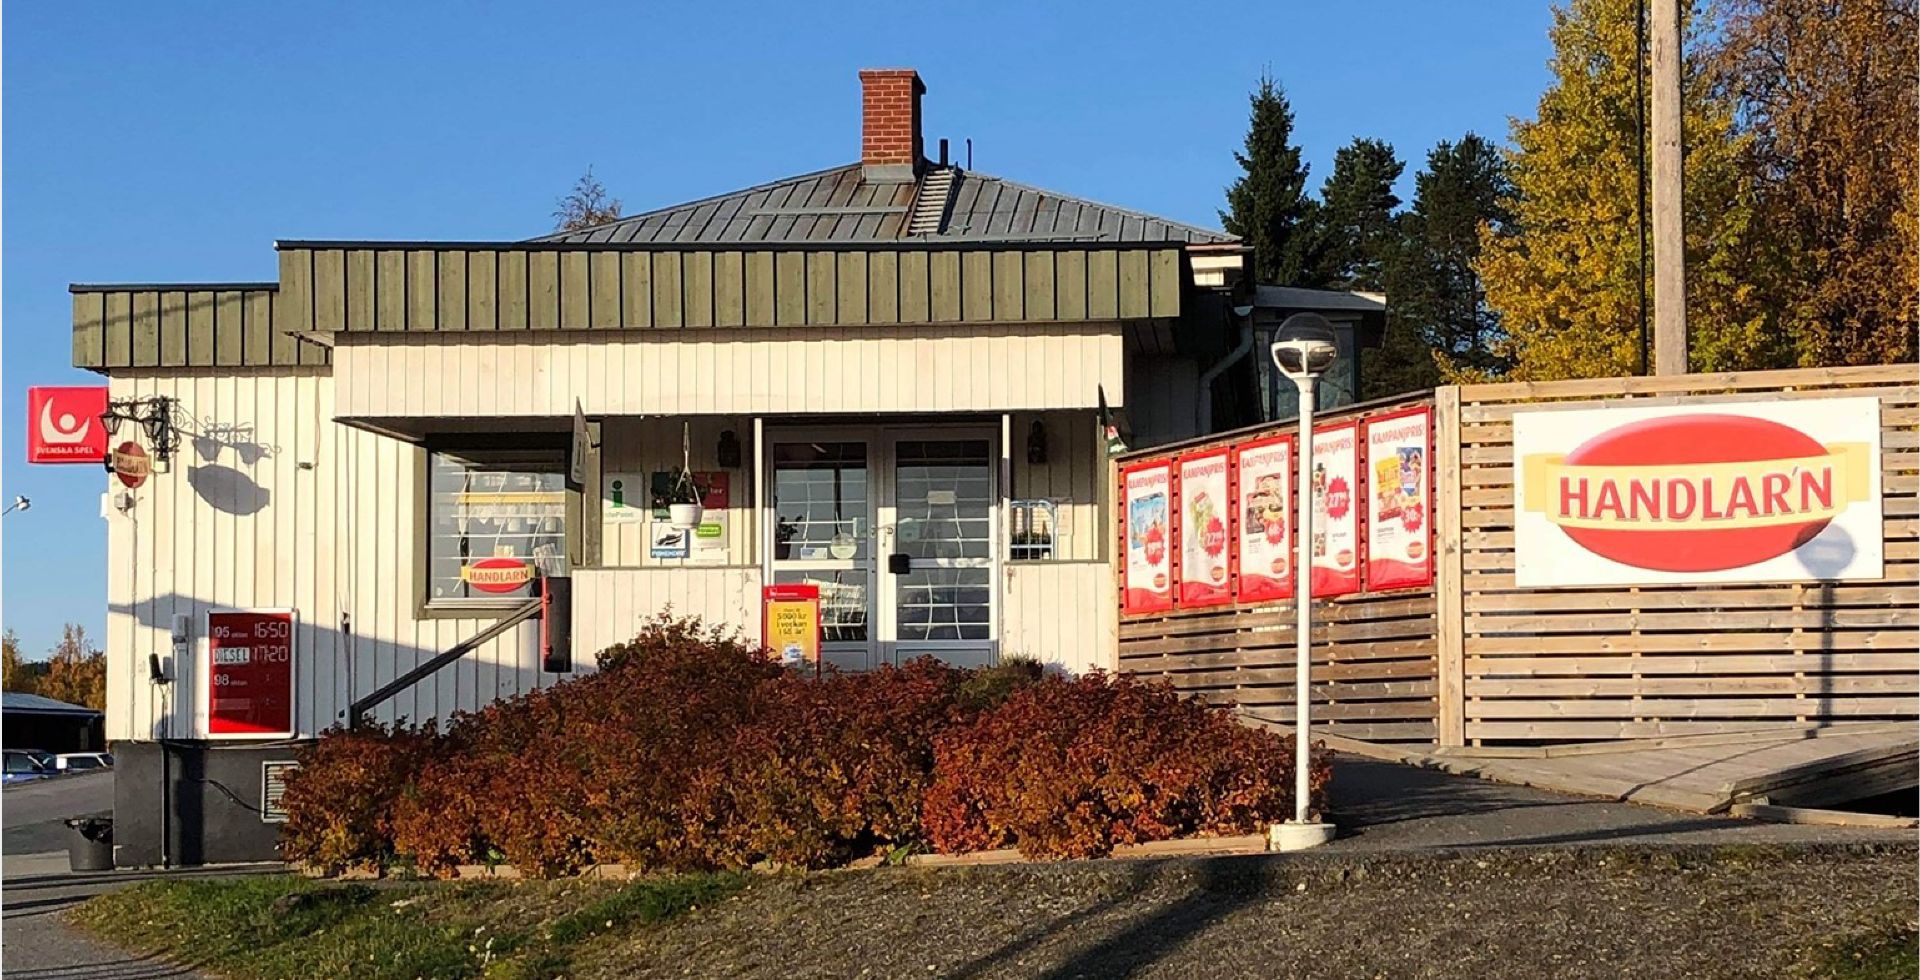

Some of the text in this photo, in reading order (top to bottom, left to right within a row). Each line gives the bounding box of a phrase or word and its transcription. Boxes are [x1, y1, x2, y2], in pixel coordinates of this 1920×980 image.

[74, 446, 94, 454] SPEL
[1559, 466, 1833, 521] HANDLAR'N
[215, 647, 247, 661] DIESEL
[213, 673, 230, 686] 98
